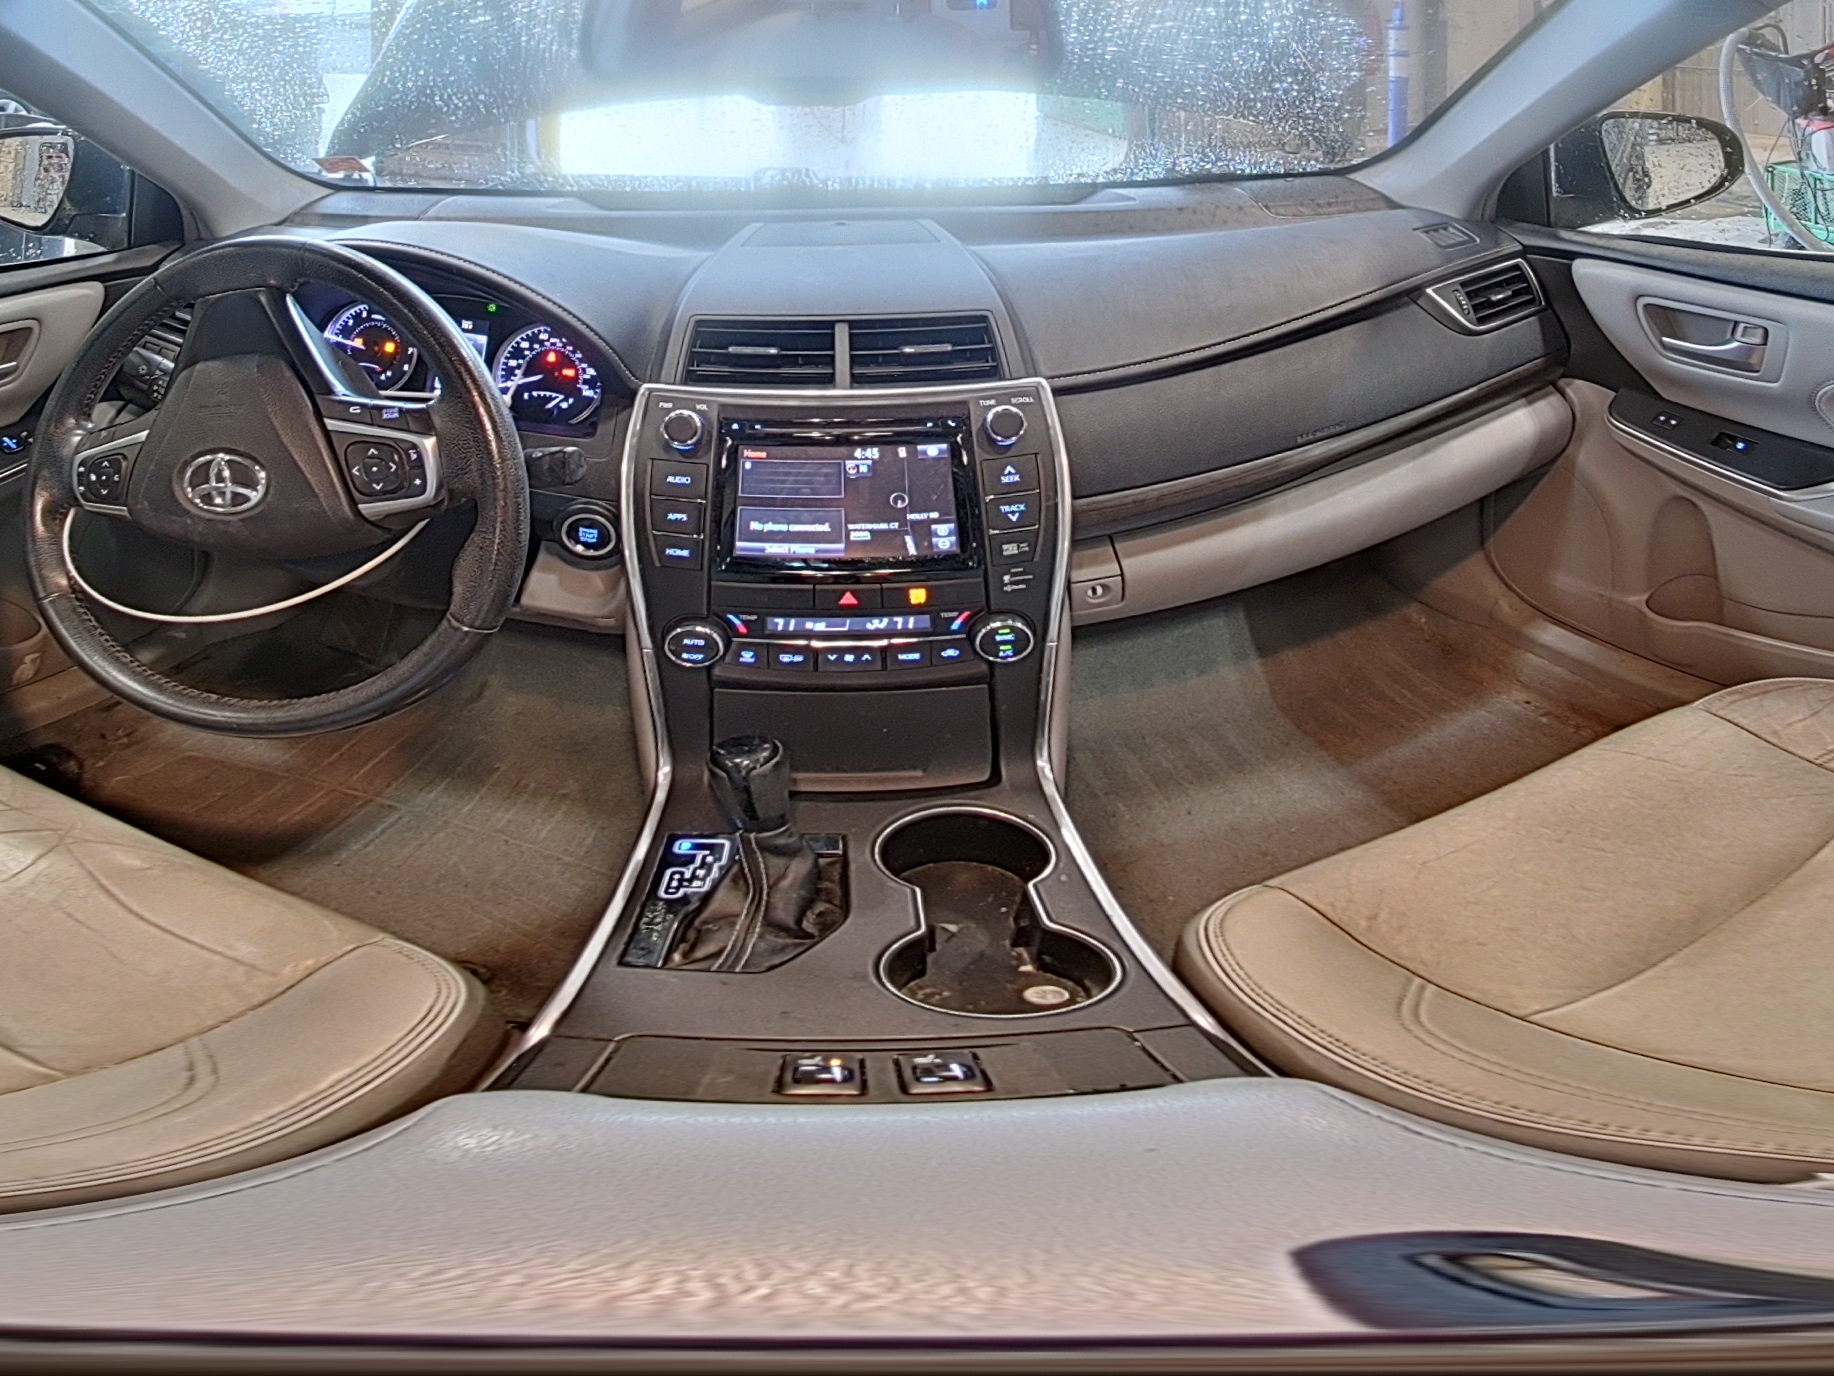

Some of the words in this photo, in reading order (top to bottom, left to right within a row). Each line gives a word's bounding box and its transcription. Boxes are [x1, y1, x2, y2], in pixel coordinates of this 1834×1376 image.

[695, 403, 708, 411] VOL
[743, 448, 767, 459] Home
[854, 447, 880, 460] 4:45
[666, 475, 691, 485] AUDIO
[1000, 474, 1021, 483] SEEK
[999, 503, 1026, 513] TRACK
[667, 513, 688, 521] APPS
[749, 521, 763, 531] No
[763, 521, 788, 533] phone
[665, 548, 690, 557] HOME
[774, 618, 795, 631] 71
[893, 617, 914, 629] 71
